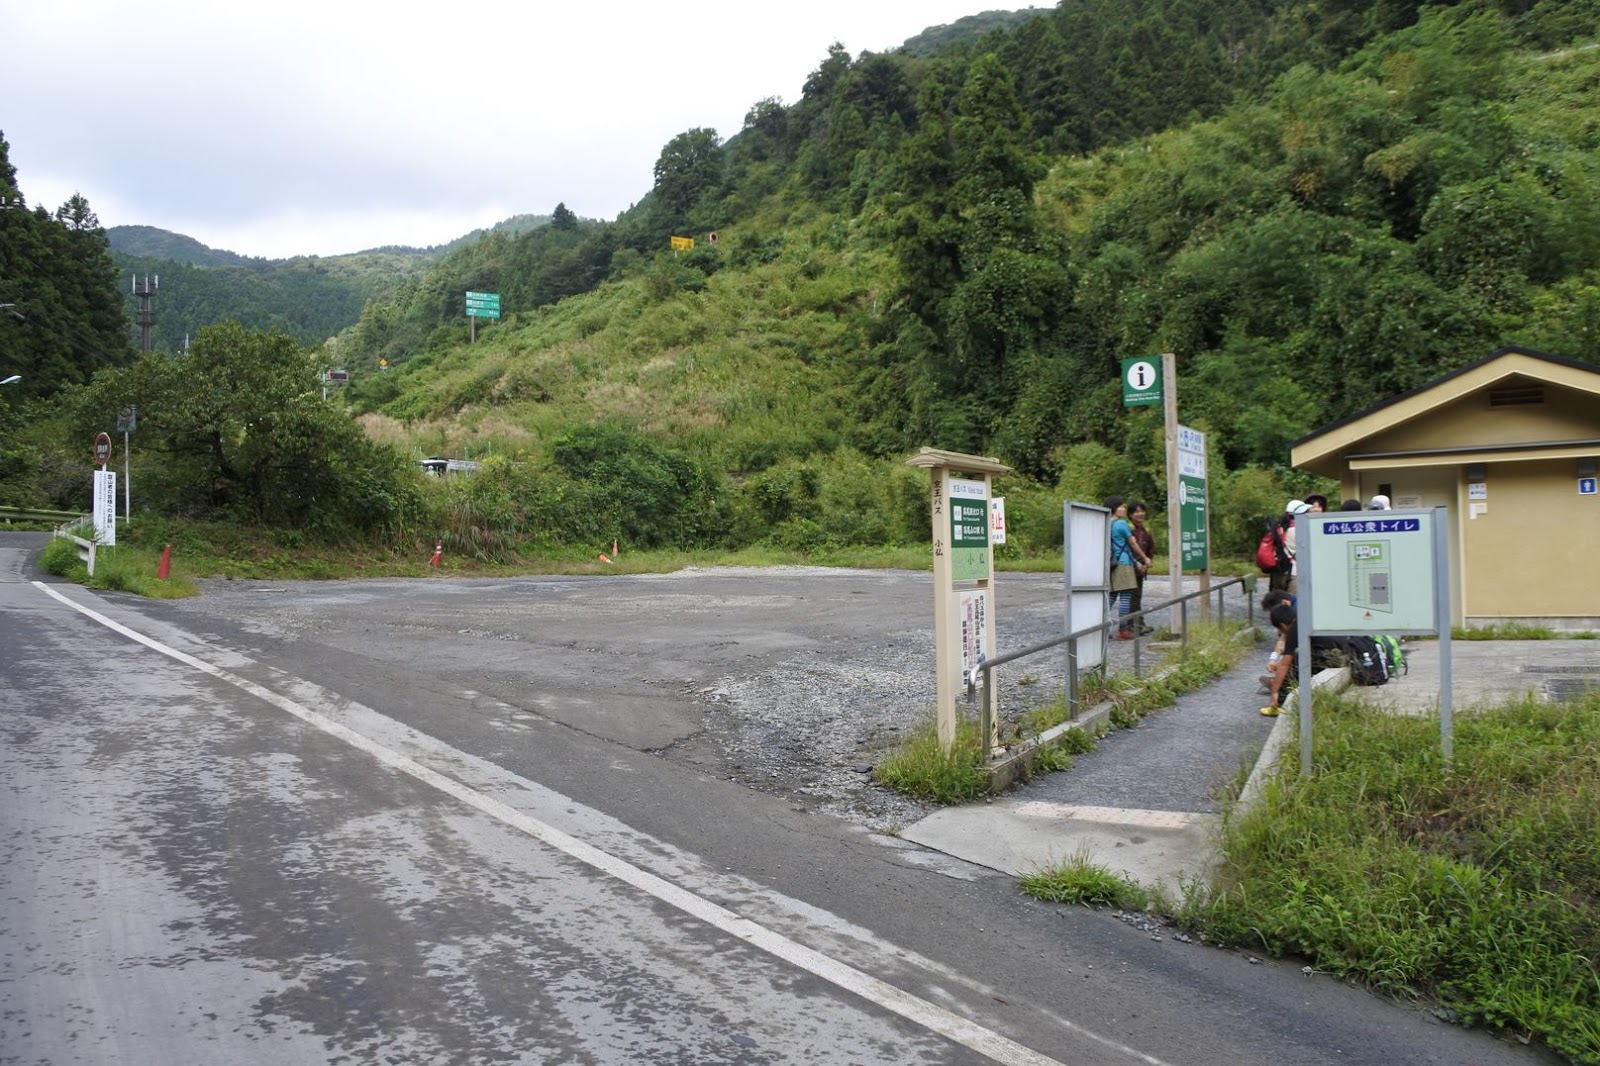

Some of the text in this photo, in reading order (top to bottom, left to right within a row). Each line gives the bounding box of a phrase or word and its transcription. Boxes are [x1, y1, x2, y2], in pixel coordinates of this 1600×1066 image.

[1328, 520, 1414, 534] 小仏公衆トイレ
[935, 540, 943, 556] 小仏
